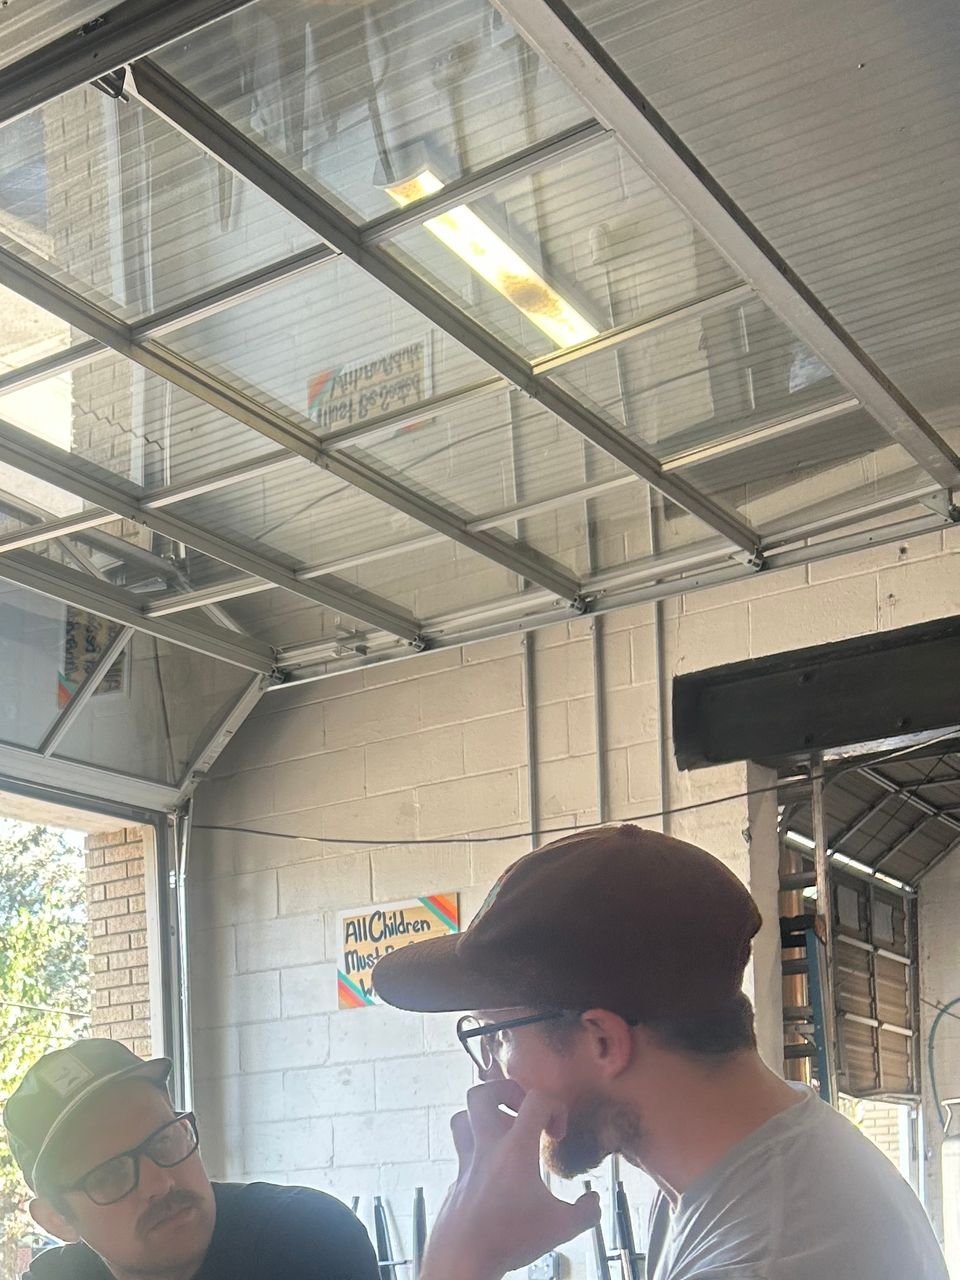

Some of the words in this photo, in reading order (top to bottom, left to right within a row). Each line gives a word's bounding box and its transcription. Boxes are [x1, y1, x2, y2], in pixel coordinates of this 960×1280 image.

[345, 918, 368, 945] All
[368, 910, 431, 943] Children
[344, 946, 383, 975] Must
